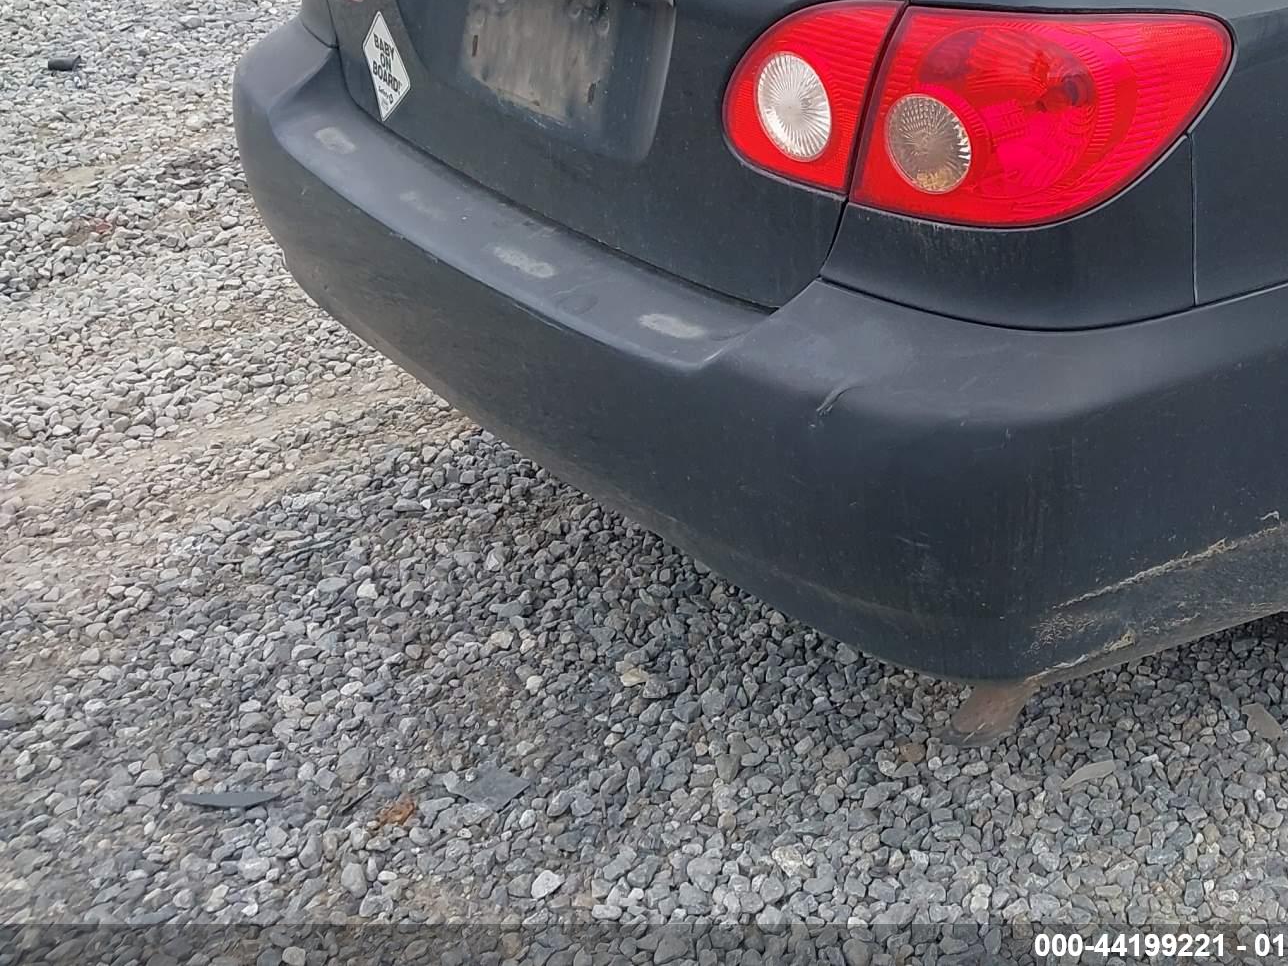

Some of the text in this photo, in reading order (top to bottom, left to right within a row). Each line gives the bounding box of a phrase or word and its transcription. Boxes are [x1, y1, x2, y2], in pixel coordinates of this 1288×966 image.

[373, 34, 395, 60] BABY
[372, 60, 403, 94] BOARD!
[379, 53, 393, 75] ON
